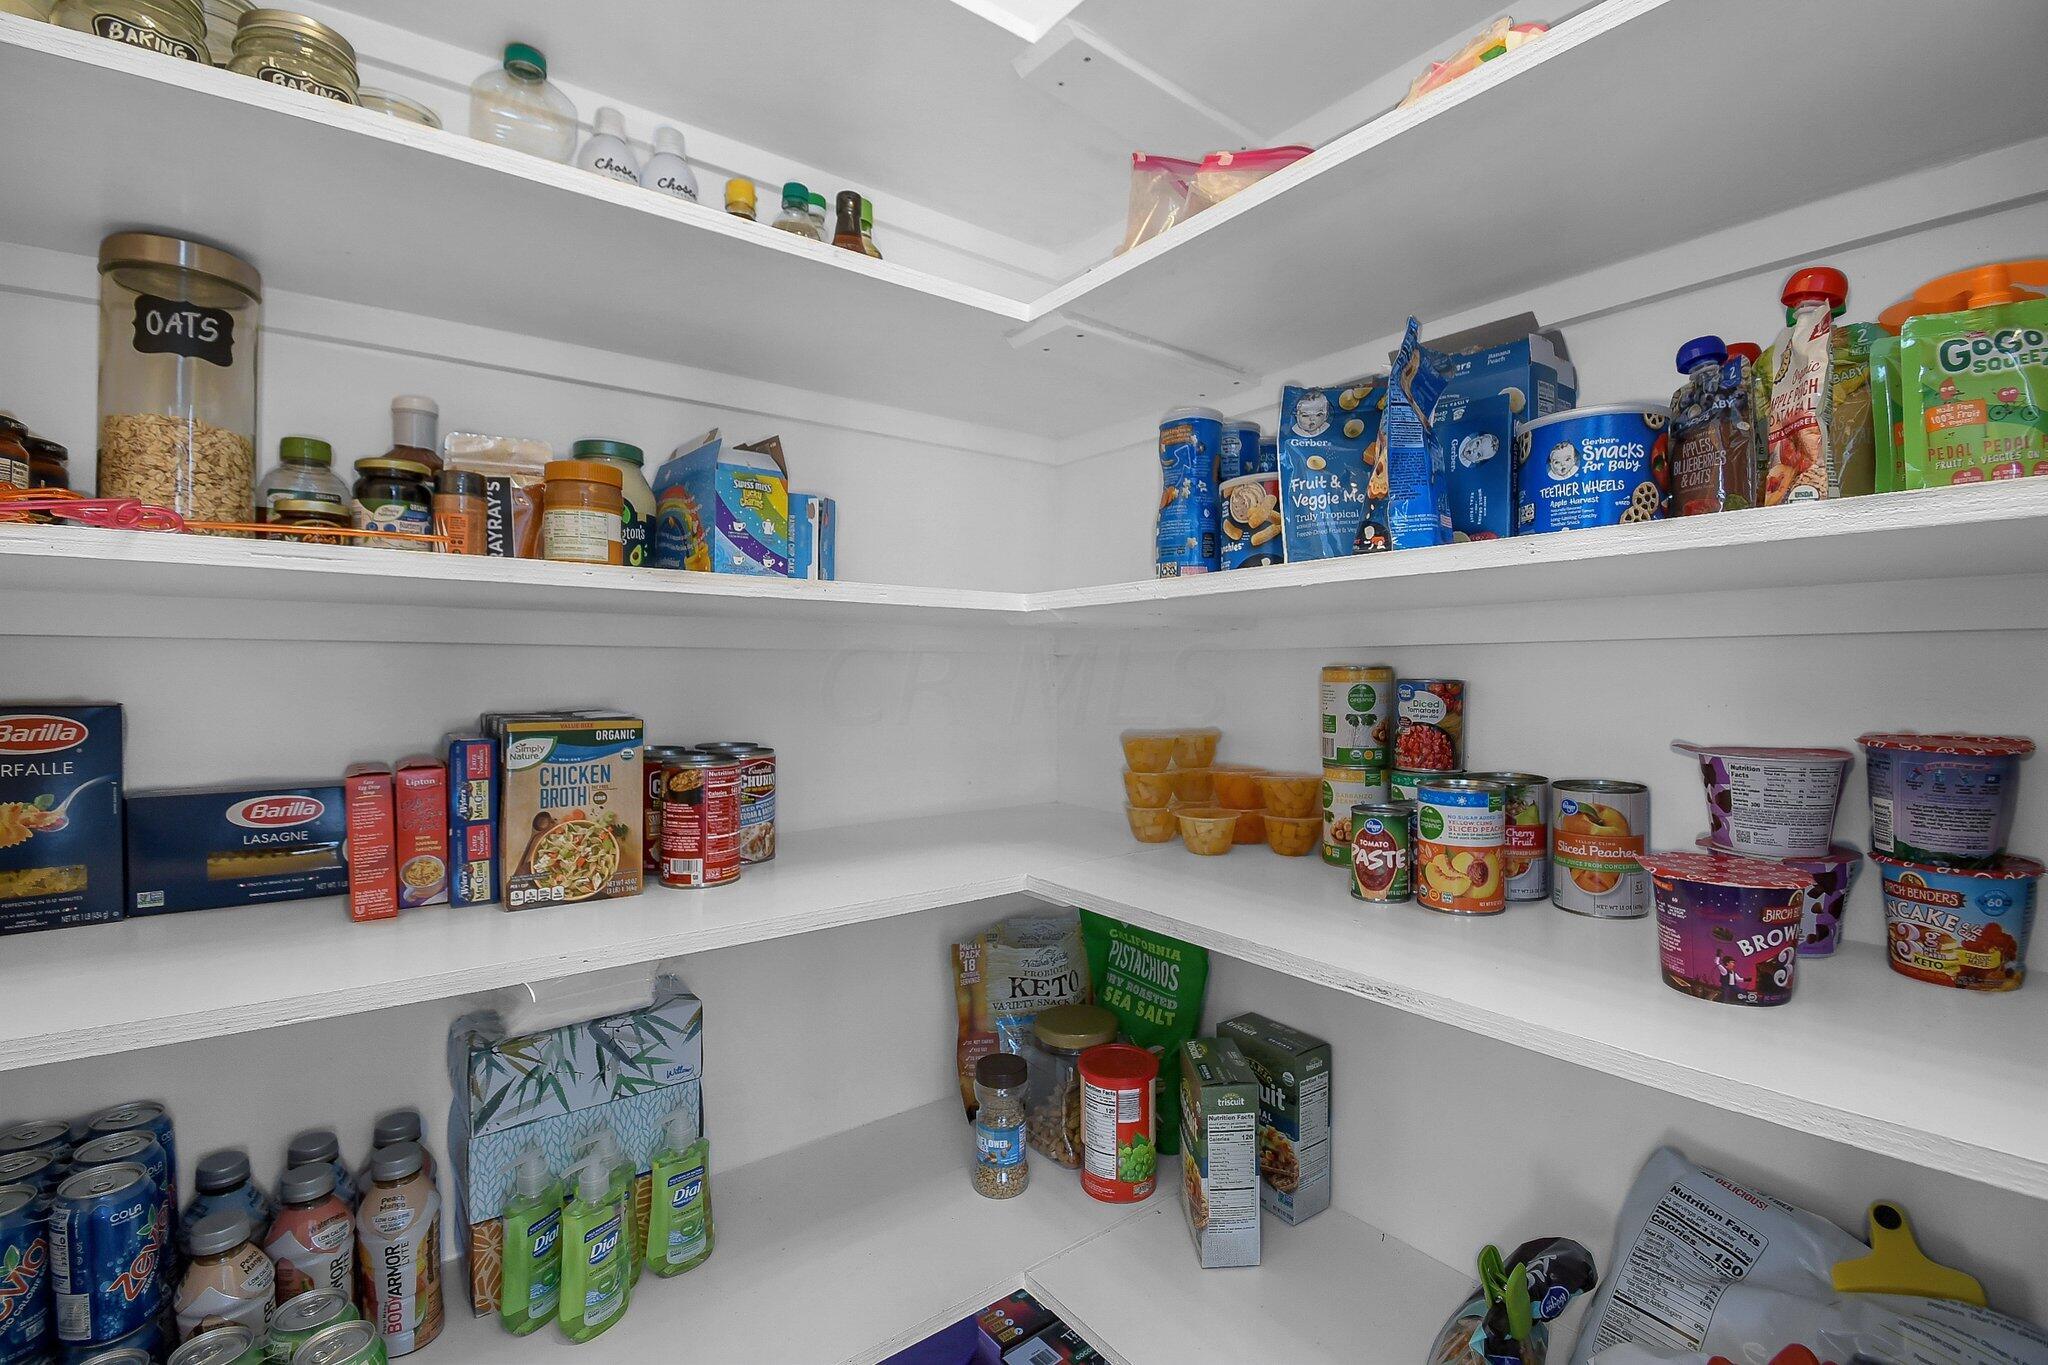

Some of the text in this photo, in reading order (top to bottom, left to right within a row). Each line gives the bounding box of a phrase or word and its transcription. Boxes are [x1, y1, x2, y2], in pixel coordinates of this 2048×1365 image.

[108, 22, 188, 61] BAKING
[146, 310, 219, 343] OATS
[1857, 329, 1869, 343] 2
[1729, 366, 1736, 380] 2
[1833, 366, 1864, 385] BABY
[1931, 412, 1955, 424] 100%
[1290, 438, 1329, 448] Gerber
[1582, 438, 1616, 446] Gerber
[1682, 438, 1714, 459] APPLES,
[1928, 434, 2031, 461] PEDAL PEDAL
[1451, 438, 1459, 471] Gerber
[1582, 442, 1645, 461] Snacks
[1936, 460, 1964, 470] FRUIT
[1981, 450, 2023, 464] VEGGIES
[1582, 459, 1642, 474] for Baby
[1673, 450, 1727, 476] BLUEBERRIES
[1292, 474, 1341, 492] Fruit &
[1681, 469, 1711, 488] & OATS
[1540, 480, 1625, 499] TEETHER WHEELS
[1794, 491, 1814, 499] USDA
[1292, 492, 1340, 511] Veggie
[1550, 496, 1600, 509] Apple Harvest
[1295, 509, 1359, 522] Truly Tropical
[787, 558, 795, 574] CAKE
[1413, 700, 1440, 708] Diced
[0, 724, 77, 742] Barilla
[595, 729, 636, 741] ORGANIC
[509, 752, 540, 761] Nature
[515, 743, 545, 755] Simply
[540, 764, 611, 787] CHICKEN
[1730, 764, 1761, 772] Nutrition
[1731, 771, 1749, 779] Facts
[405, 778, 436, 790] Lipton
[540, 786, 587, 809] BROTH
[250, 801, 316, 819] Barilla
[243, 831, 309, 845] LASAGNE
[1448, 825, 1479, 833] SLICED
[1505, 828, 1535, 838] Cherry
[1360, 839, 1389, 848] TOMATO
[1512, 837, 1533, 846] Fruit
[1558, 840, 1637, 858] Sliced Peaches
[1351, 843, 1406, 870] PASTE
[1907, 887, 1958, 907] BENDERS
[1987, 898, 2003, 907] 60
[1762, 907, 1793, 922] BIRCH
[1109, 929, 1181, 961] CALIFORNIA
[1896, 922, 1940, 963] 3 g
[960, 949, 980, 960] PACK
[1913, 955, 1944, 969] KETO
[963, 959, 975, 972] 18
[1108, 940, 1180, 991] PISTACHIOS
[1773, 946, 1795, 988] 3
[1008, 970, 1079, 999] KETO
[1126, 980, 1178, 1010] ROASTED
[992, 998, 1070, 1011] VARIETY SNACK
[1104, 986, 1176, 1026] SEA SALT
[1226, 1021, 1257, 1036] triscuit
[1186, 1040, 1203, 1060] triscuit
[667, 1063, 693, 1080] Willow
[1305, 1060, 1323, 1072] triscuit
[1217, 1097, 1245, 1107] triscuit
[1259, 1084, 1286, 1111] uit
[1241, 1133, 1254, 1141] 120
[381, 1194, 405, 1205] Peach
[674, 1181, 702, 1202] Dial
[1715, 1177, 1769, 1211] DELICIOUS!
[110, 1203, 143, 1223] COLA
[379, 1202, 406, 1212] Mango
[1670, 1184, 1761, 1248] Nutrition Facts
[388, 1213, 410, 1222] CALORIE
[1660, 1199, 1686, 1219] Serving
[1716, 1233, 1734, 1249] cups
[1671, 1198, 1697, 1219] servings
[1697, 1215, 1706, 1225] per
[1706, 1220, 1737, 1242] container
[534, 1225, 560, 1252] Dial
[591, 1231, 618, 1258] Dial
[1650, 1212, 1744, 1279] Calories 150
[1688, 1227, 1712, 1248] serving
[400, 1241, 410, 1266] LYTE
[1699, 1255, 1715, 1273] Daily
[385, 1244, 402, 1335] BODYARMOR
